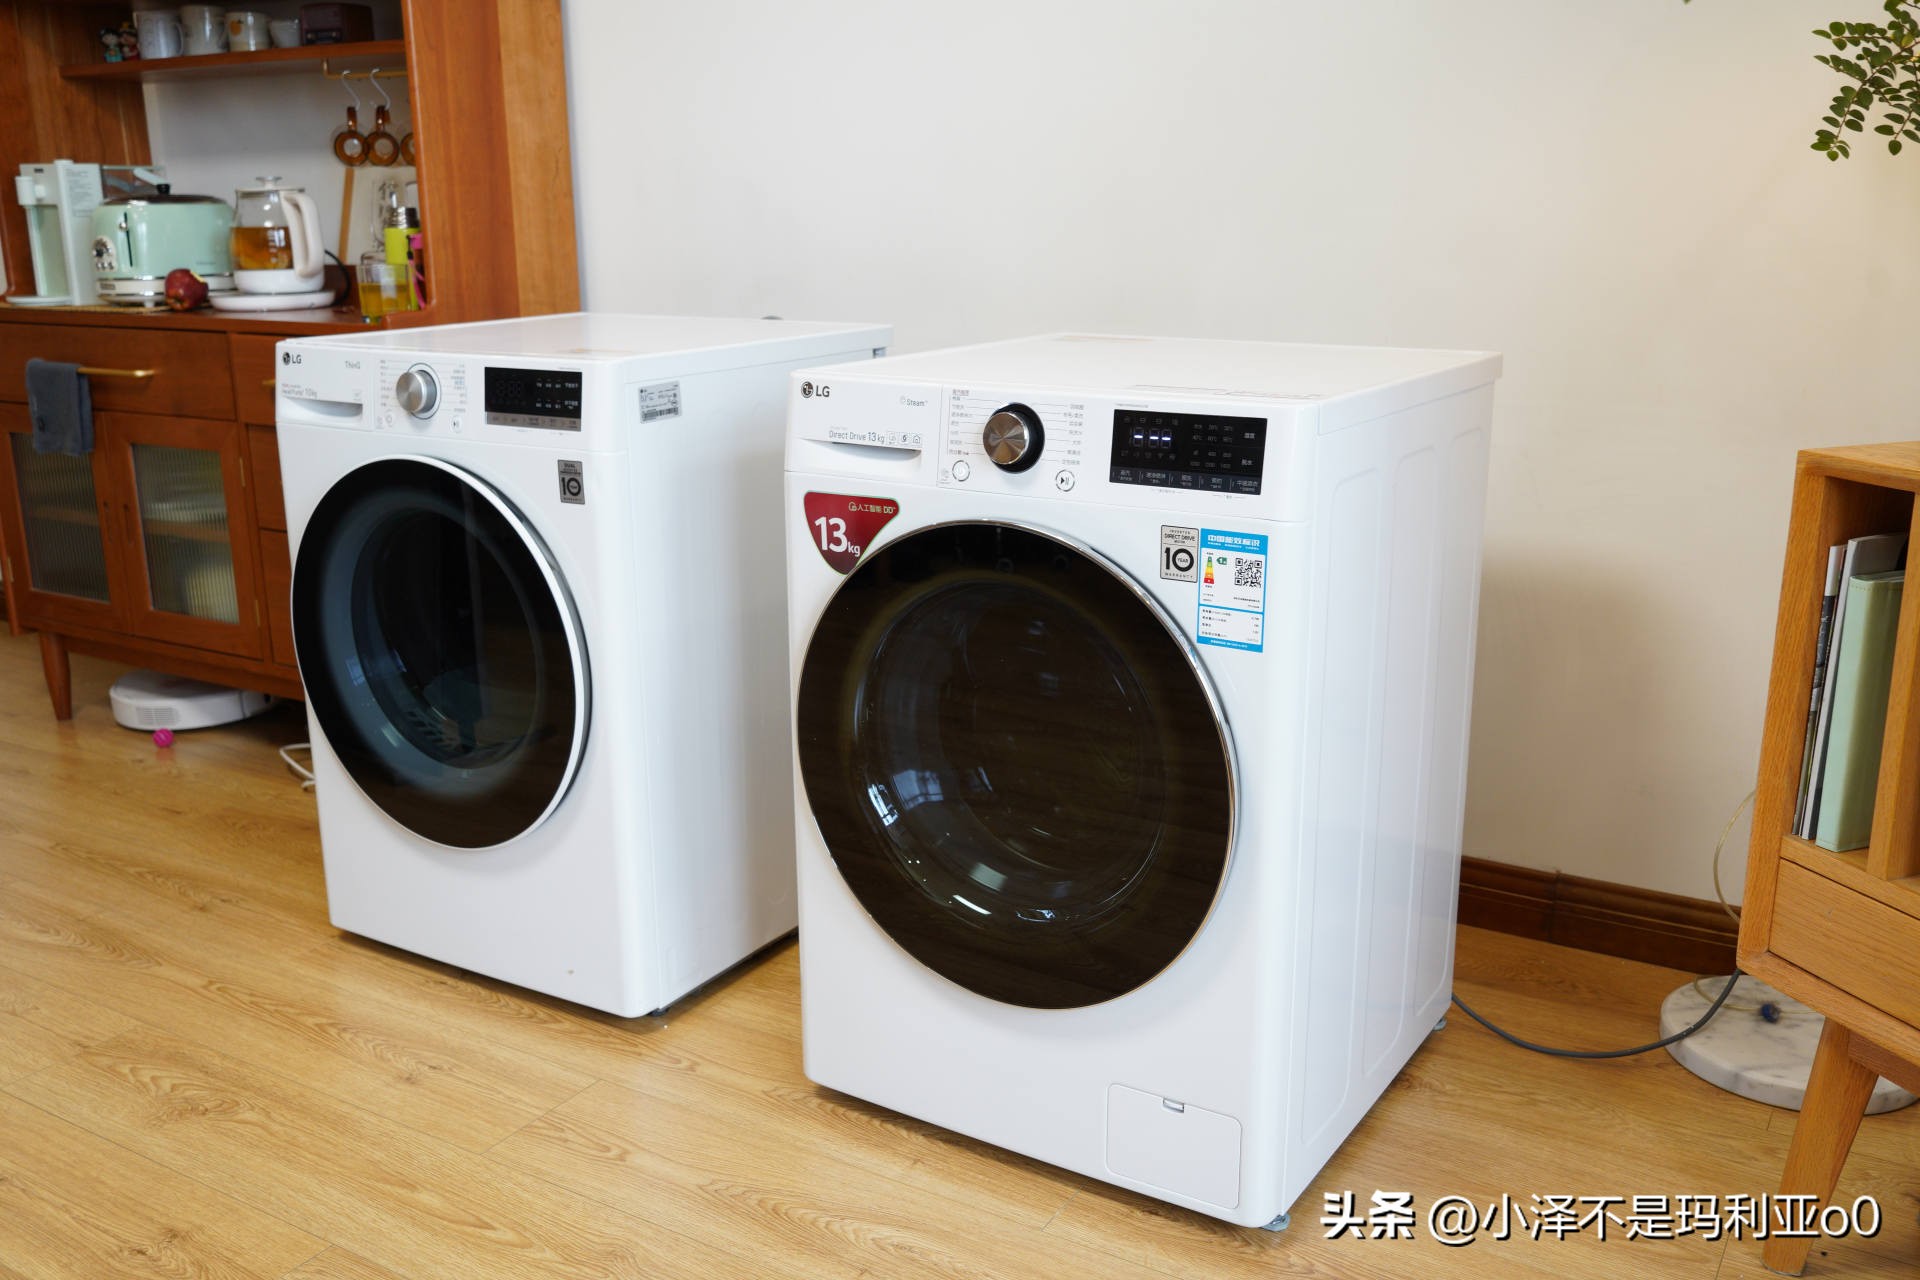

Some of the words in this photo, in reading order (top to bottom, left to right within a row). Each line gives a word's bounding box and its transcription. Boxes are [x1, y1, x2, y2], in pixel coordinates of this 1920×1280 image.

[291, 354, 302, 364] LG
[815, 385, 830, 397] LG
[906, 398, 926, 407] Steam
[828, 430, 848, 439] Direct
[849, 431, 867, 441] Drive
[561, 476, 582, 497] 10
[857, 504, 883, 513] 人工智能
[1207, 534, 1261, 547] 中国能效标识
[1164, 546, 1195, 572] 10
